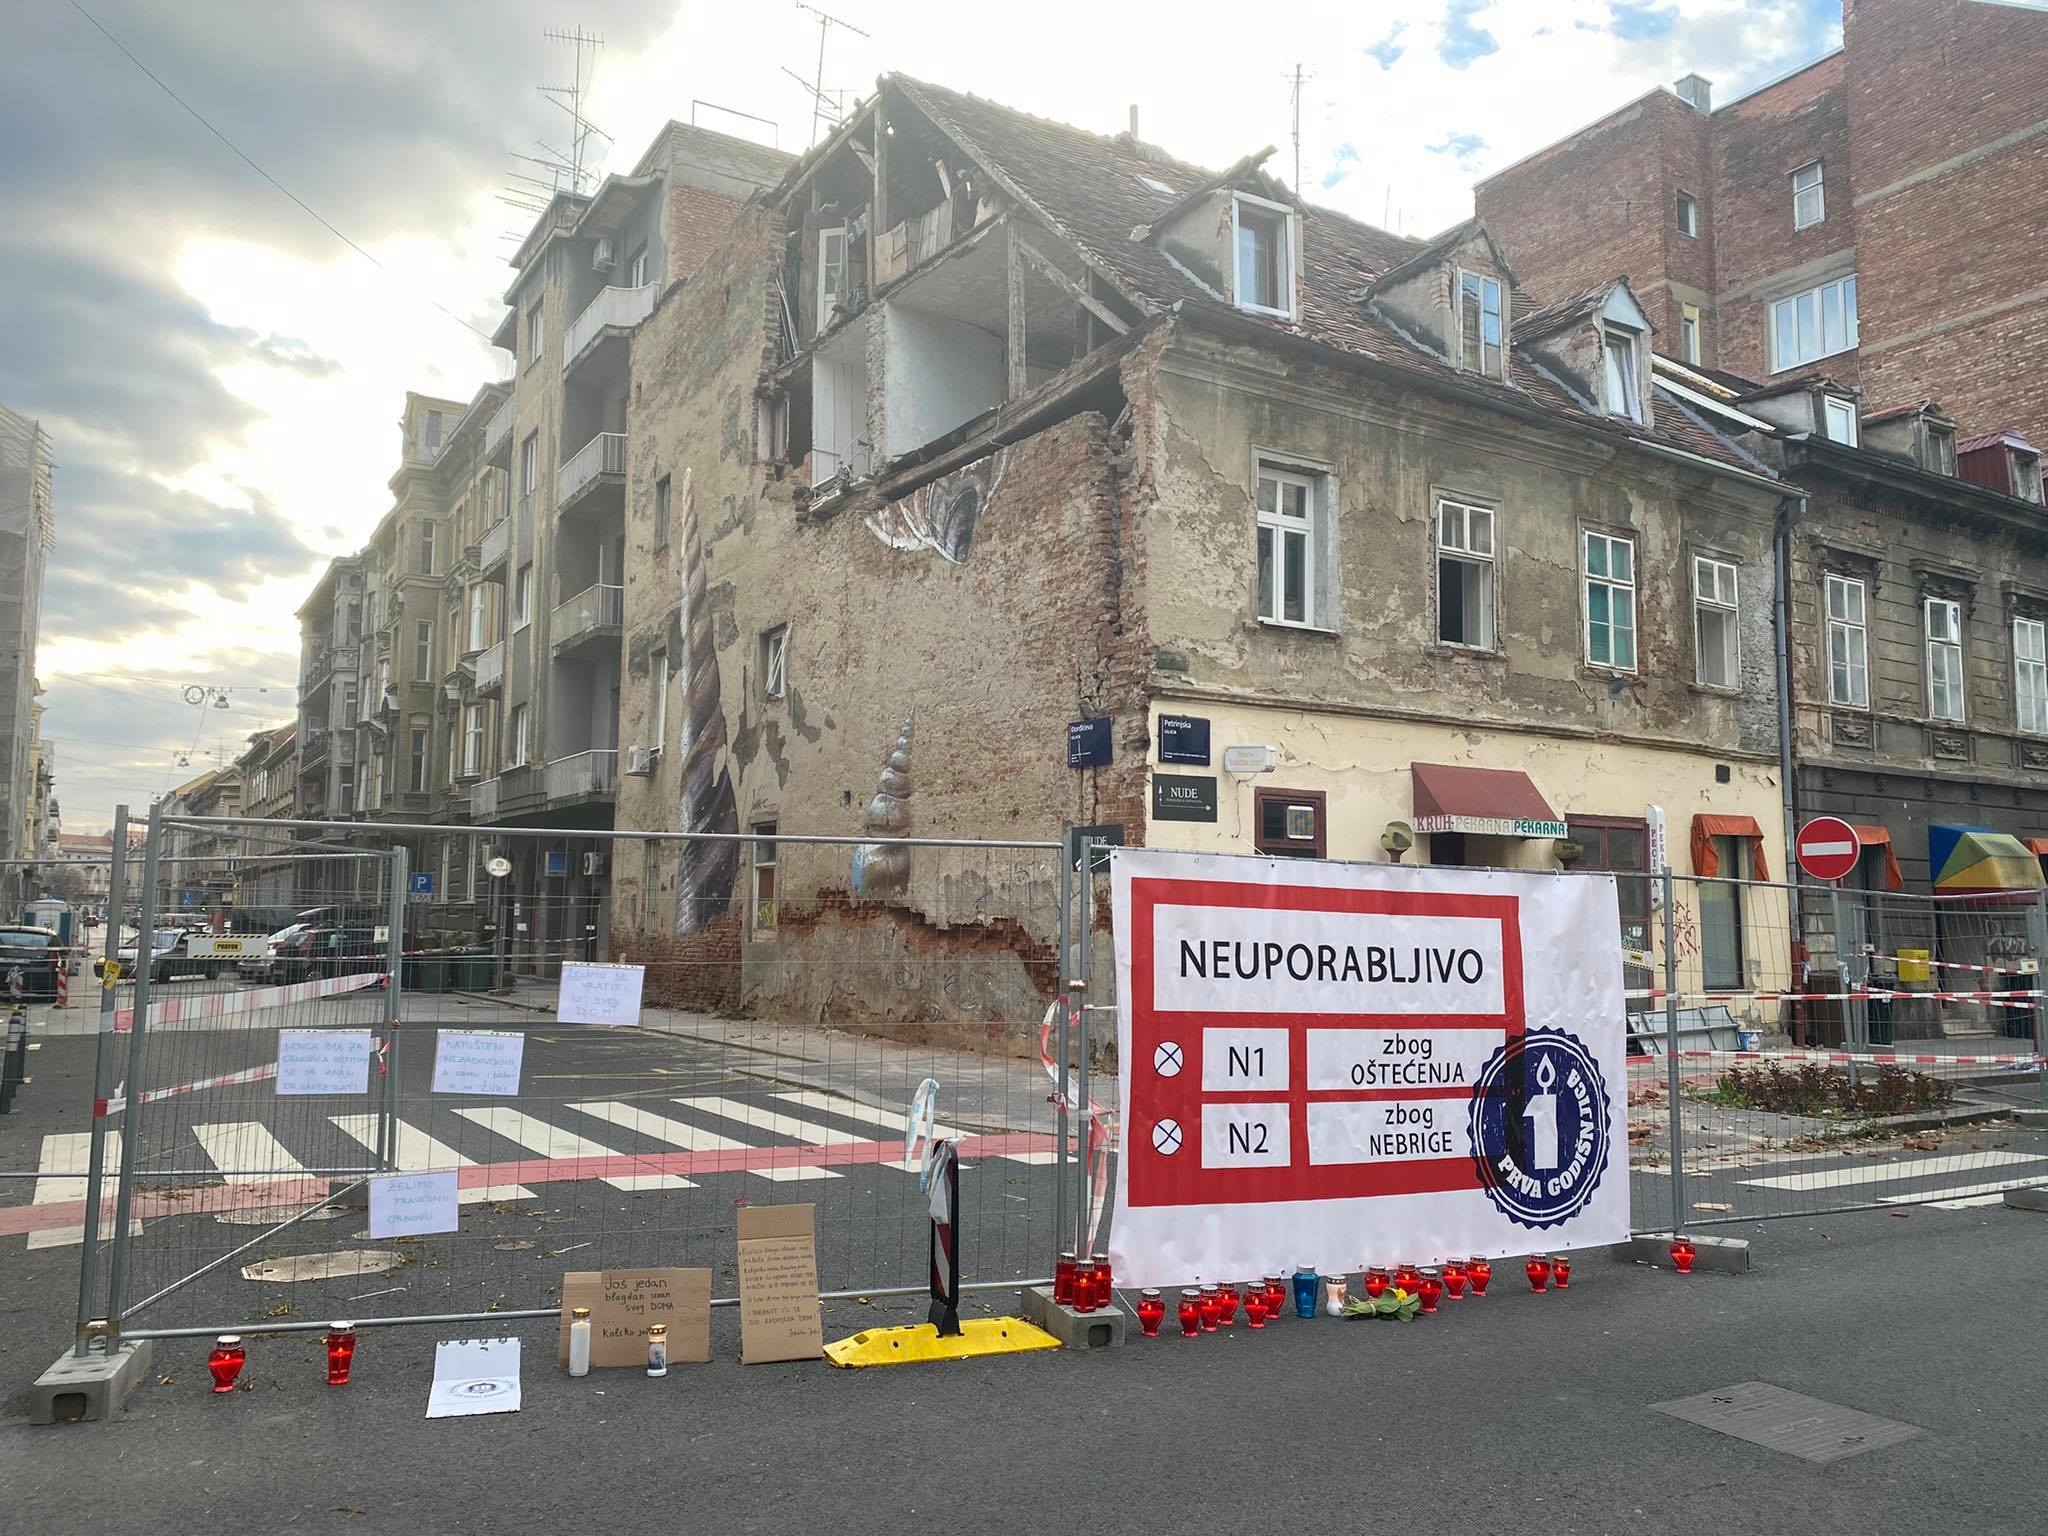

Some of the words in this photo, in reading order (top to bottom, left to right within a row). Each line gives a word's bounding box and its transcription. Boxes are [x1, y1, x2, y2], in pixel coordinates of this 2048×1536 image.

[1164, 719, 1191, 730] Petrinjska
[1170, 787, 1198, 799] NUDE
[1417, 815, 1451, 832] KRUH
[1456, 817, 1510, 832] PEKARNA
[1514, 821, 1565, 835] PEKARNA
[1088, 836, 1107, 845] UDE
[417, 876, 426, 888] P
[1180, 940, 1483, 984] NEUPORABLJIVO
[1383, 1033, 1433, 1059] zbog
[1228, 1046, 1265, 1077] N1
[1351, 1059, 1465, 1085] OŠTEĆENJA
[1385, 1103, 1434, 1129] zbog
[1228, 1123, 1269, 1153] N2
[1498, 1154, 1542, 1198] PRVA
[1547, 1068, 1594, 1197] GODIŠNJICA
[1370, 1131, 1453, 1157] NEBRIGE
[387, 1180, 435, 1192] ŽELIMO
[633, 1277, 668, 1292] jedan
[605, 1292, 645, 1305] blagdan
[650, 1302, 674, 1311] DOMA
